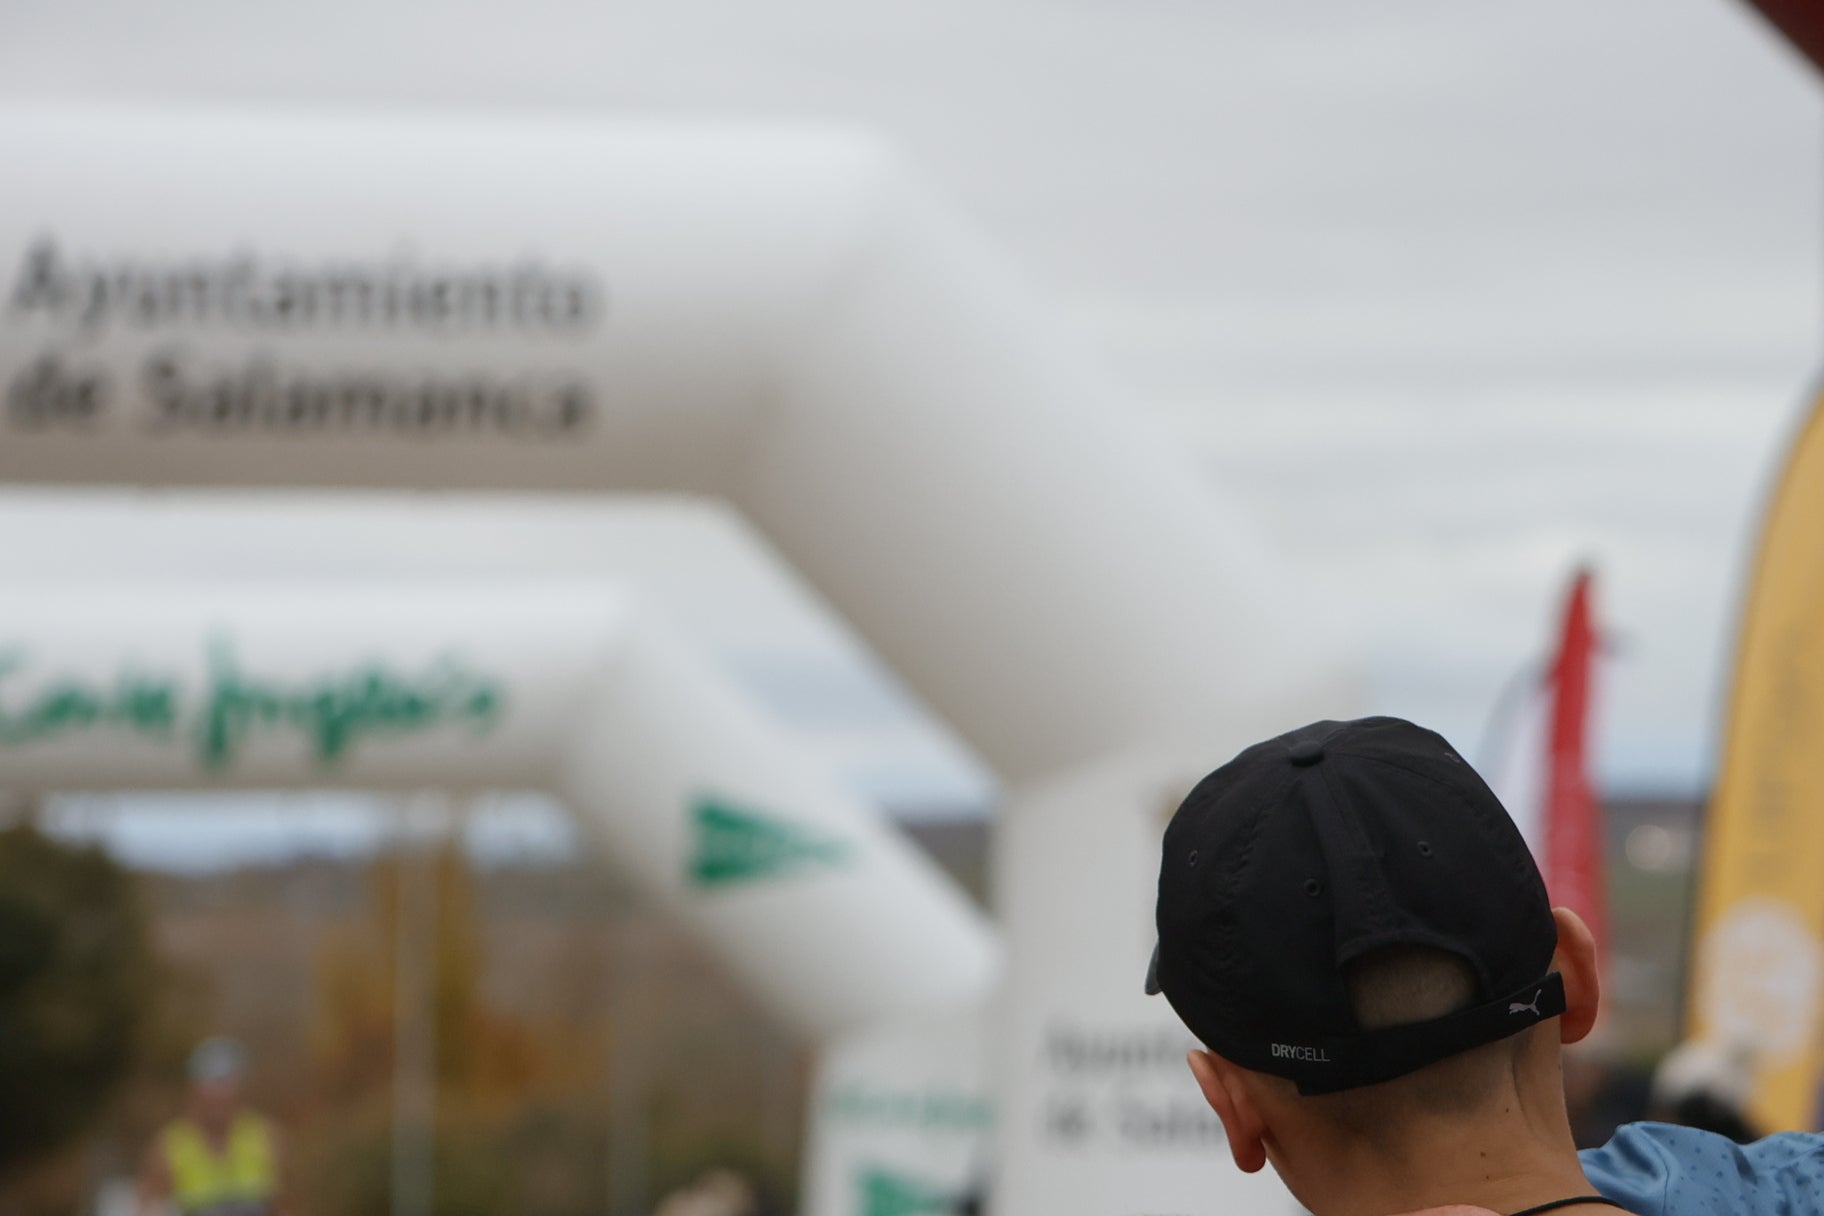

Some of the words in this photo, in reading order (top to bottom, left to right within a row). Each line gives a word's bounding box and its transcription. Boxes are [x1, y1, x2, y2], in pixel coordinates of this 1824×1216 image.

[12, 234, 603, 338] Ayuntamiento
[10, 352, 104, 433] de
[142, 345, 597, 437] Salamanca
[1271, 1043, 1331, 1062] DRYCELL
